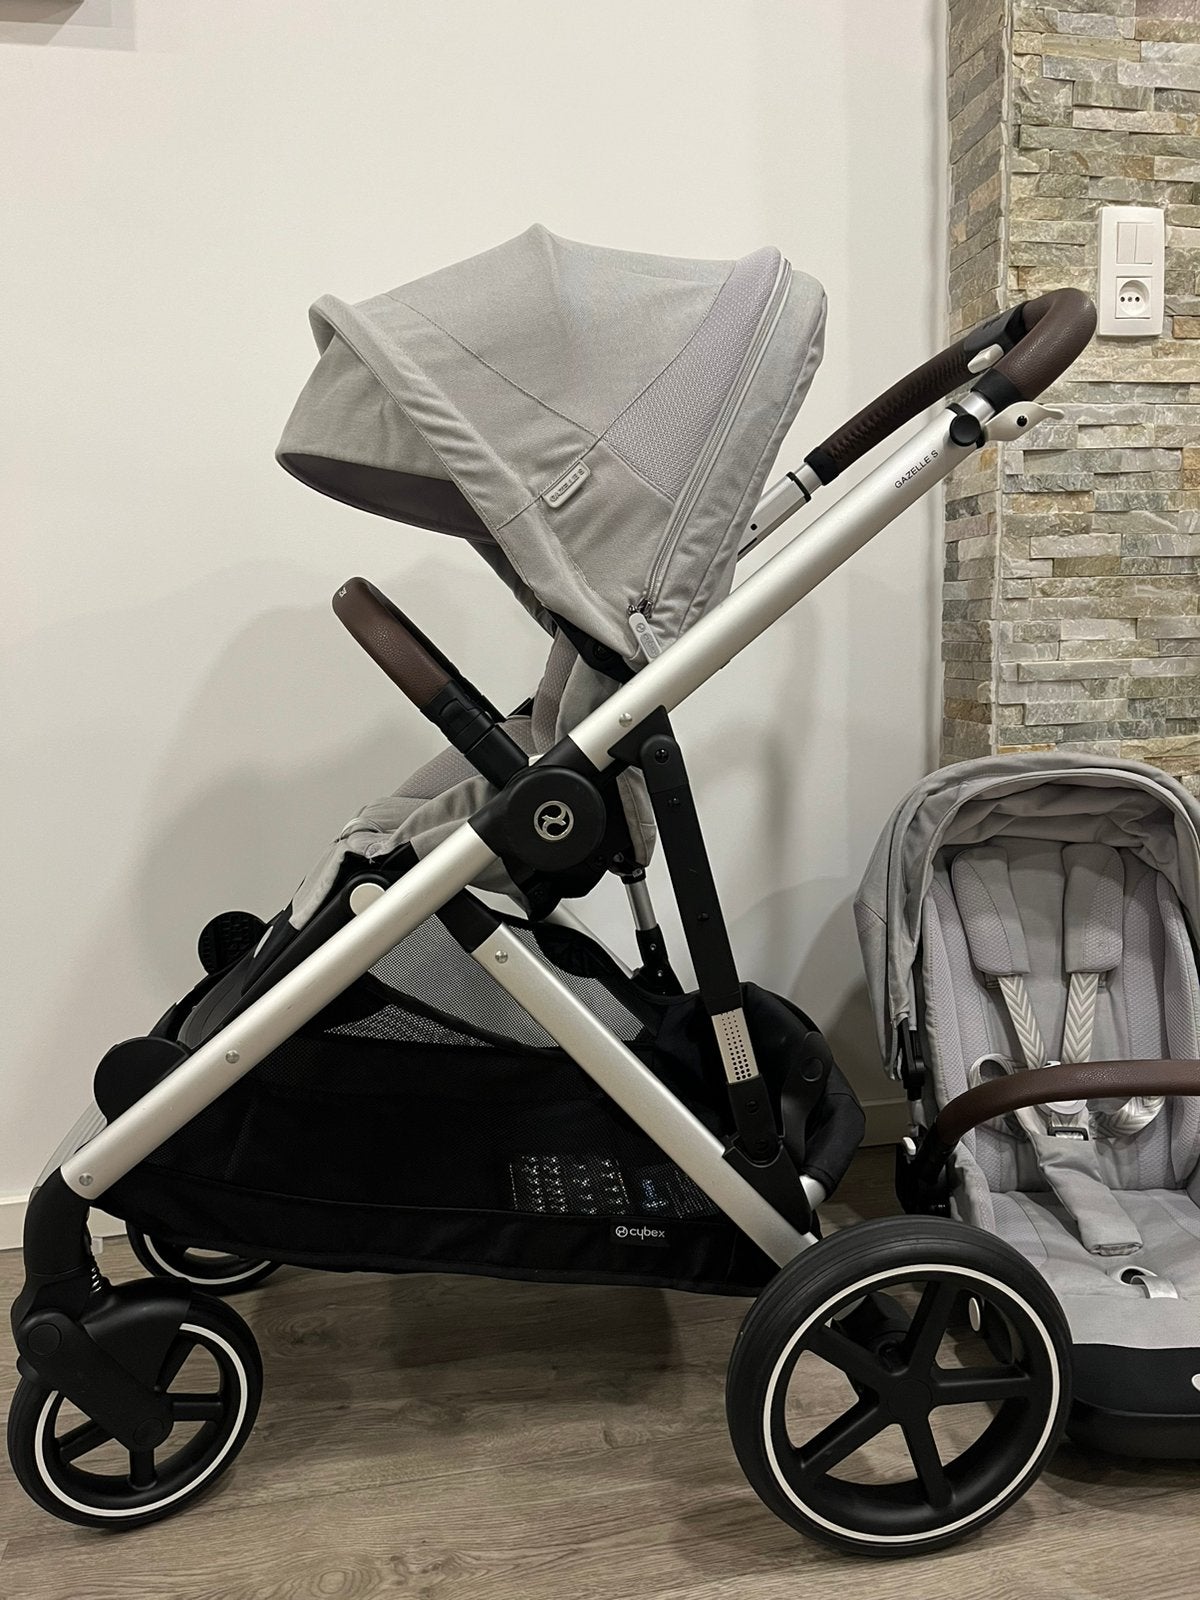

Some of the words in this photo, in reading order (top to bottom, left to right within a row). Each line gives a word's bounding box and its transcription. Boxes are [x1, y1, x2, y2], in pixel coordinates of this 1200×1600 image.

[894, 455, 932, 489] GAZELLE
[930, 449, 939, 458] S
[629, 1225, 665, 1240] cybex
